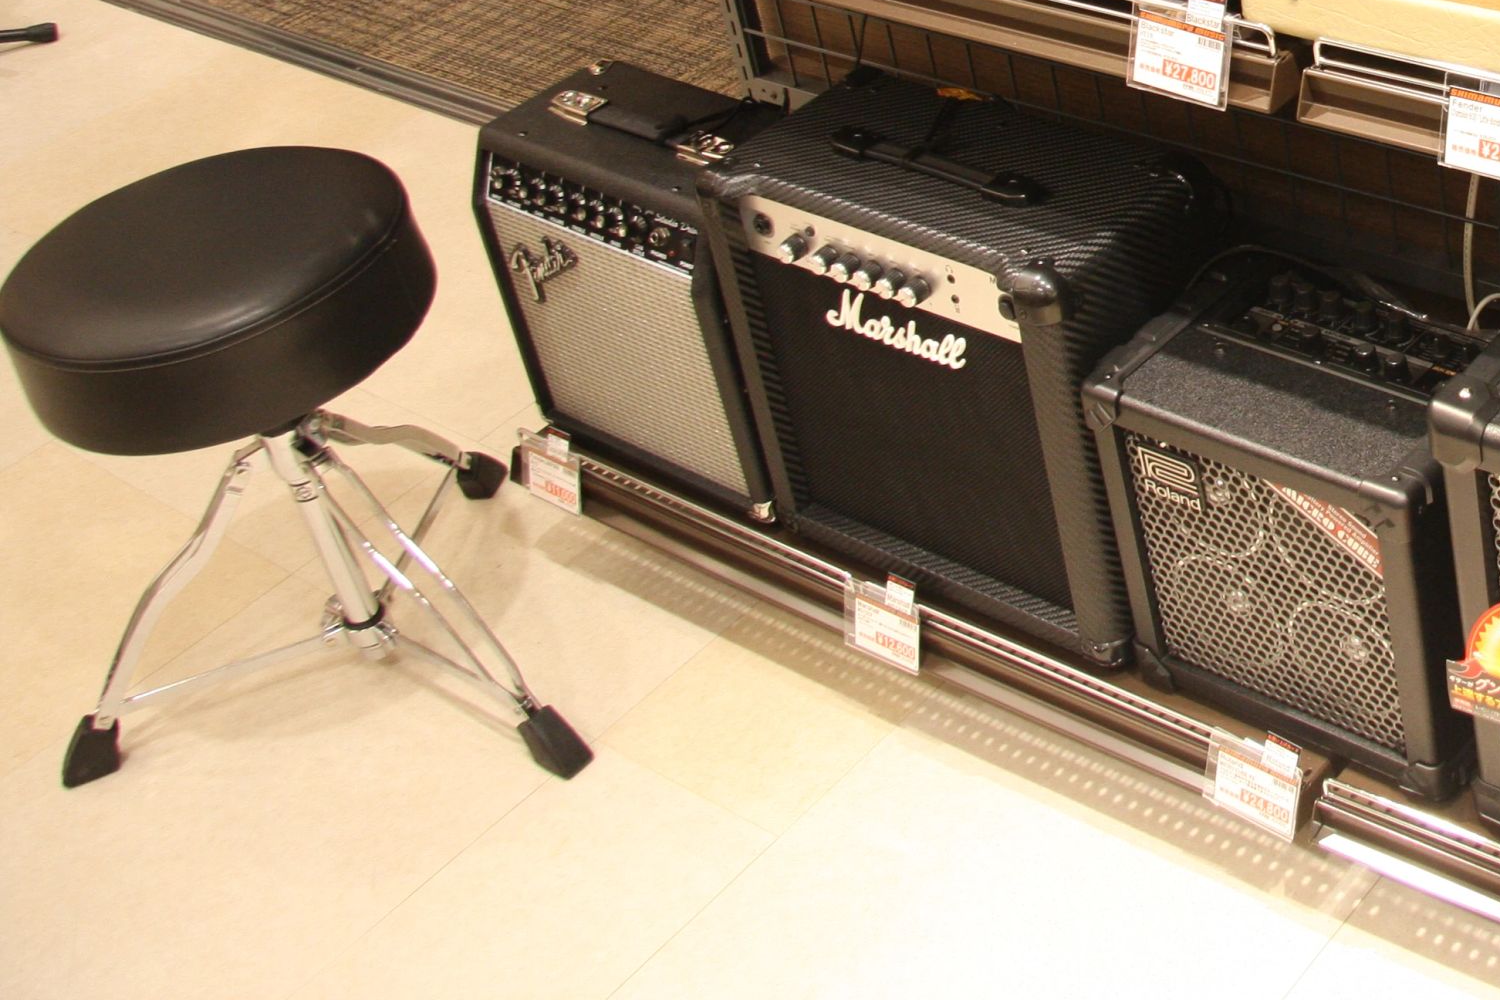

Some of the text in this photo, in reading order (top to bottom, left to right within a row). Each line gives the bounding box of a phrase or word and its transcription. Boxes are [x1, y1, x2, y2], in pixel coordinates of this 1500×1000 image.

[1164, 61, 1216, 89] ¥27,800
[825, 288, 967, 370] Marshall
[1144, 478, 1202, 512] Roland
[1281, 486, 1381, 569] MICRO CUBE
